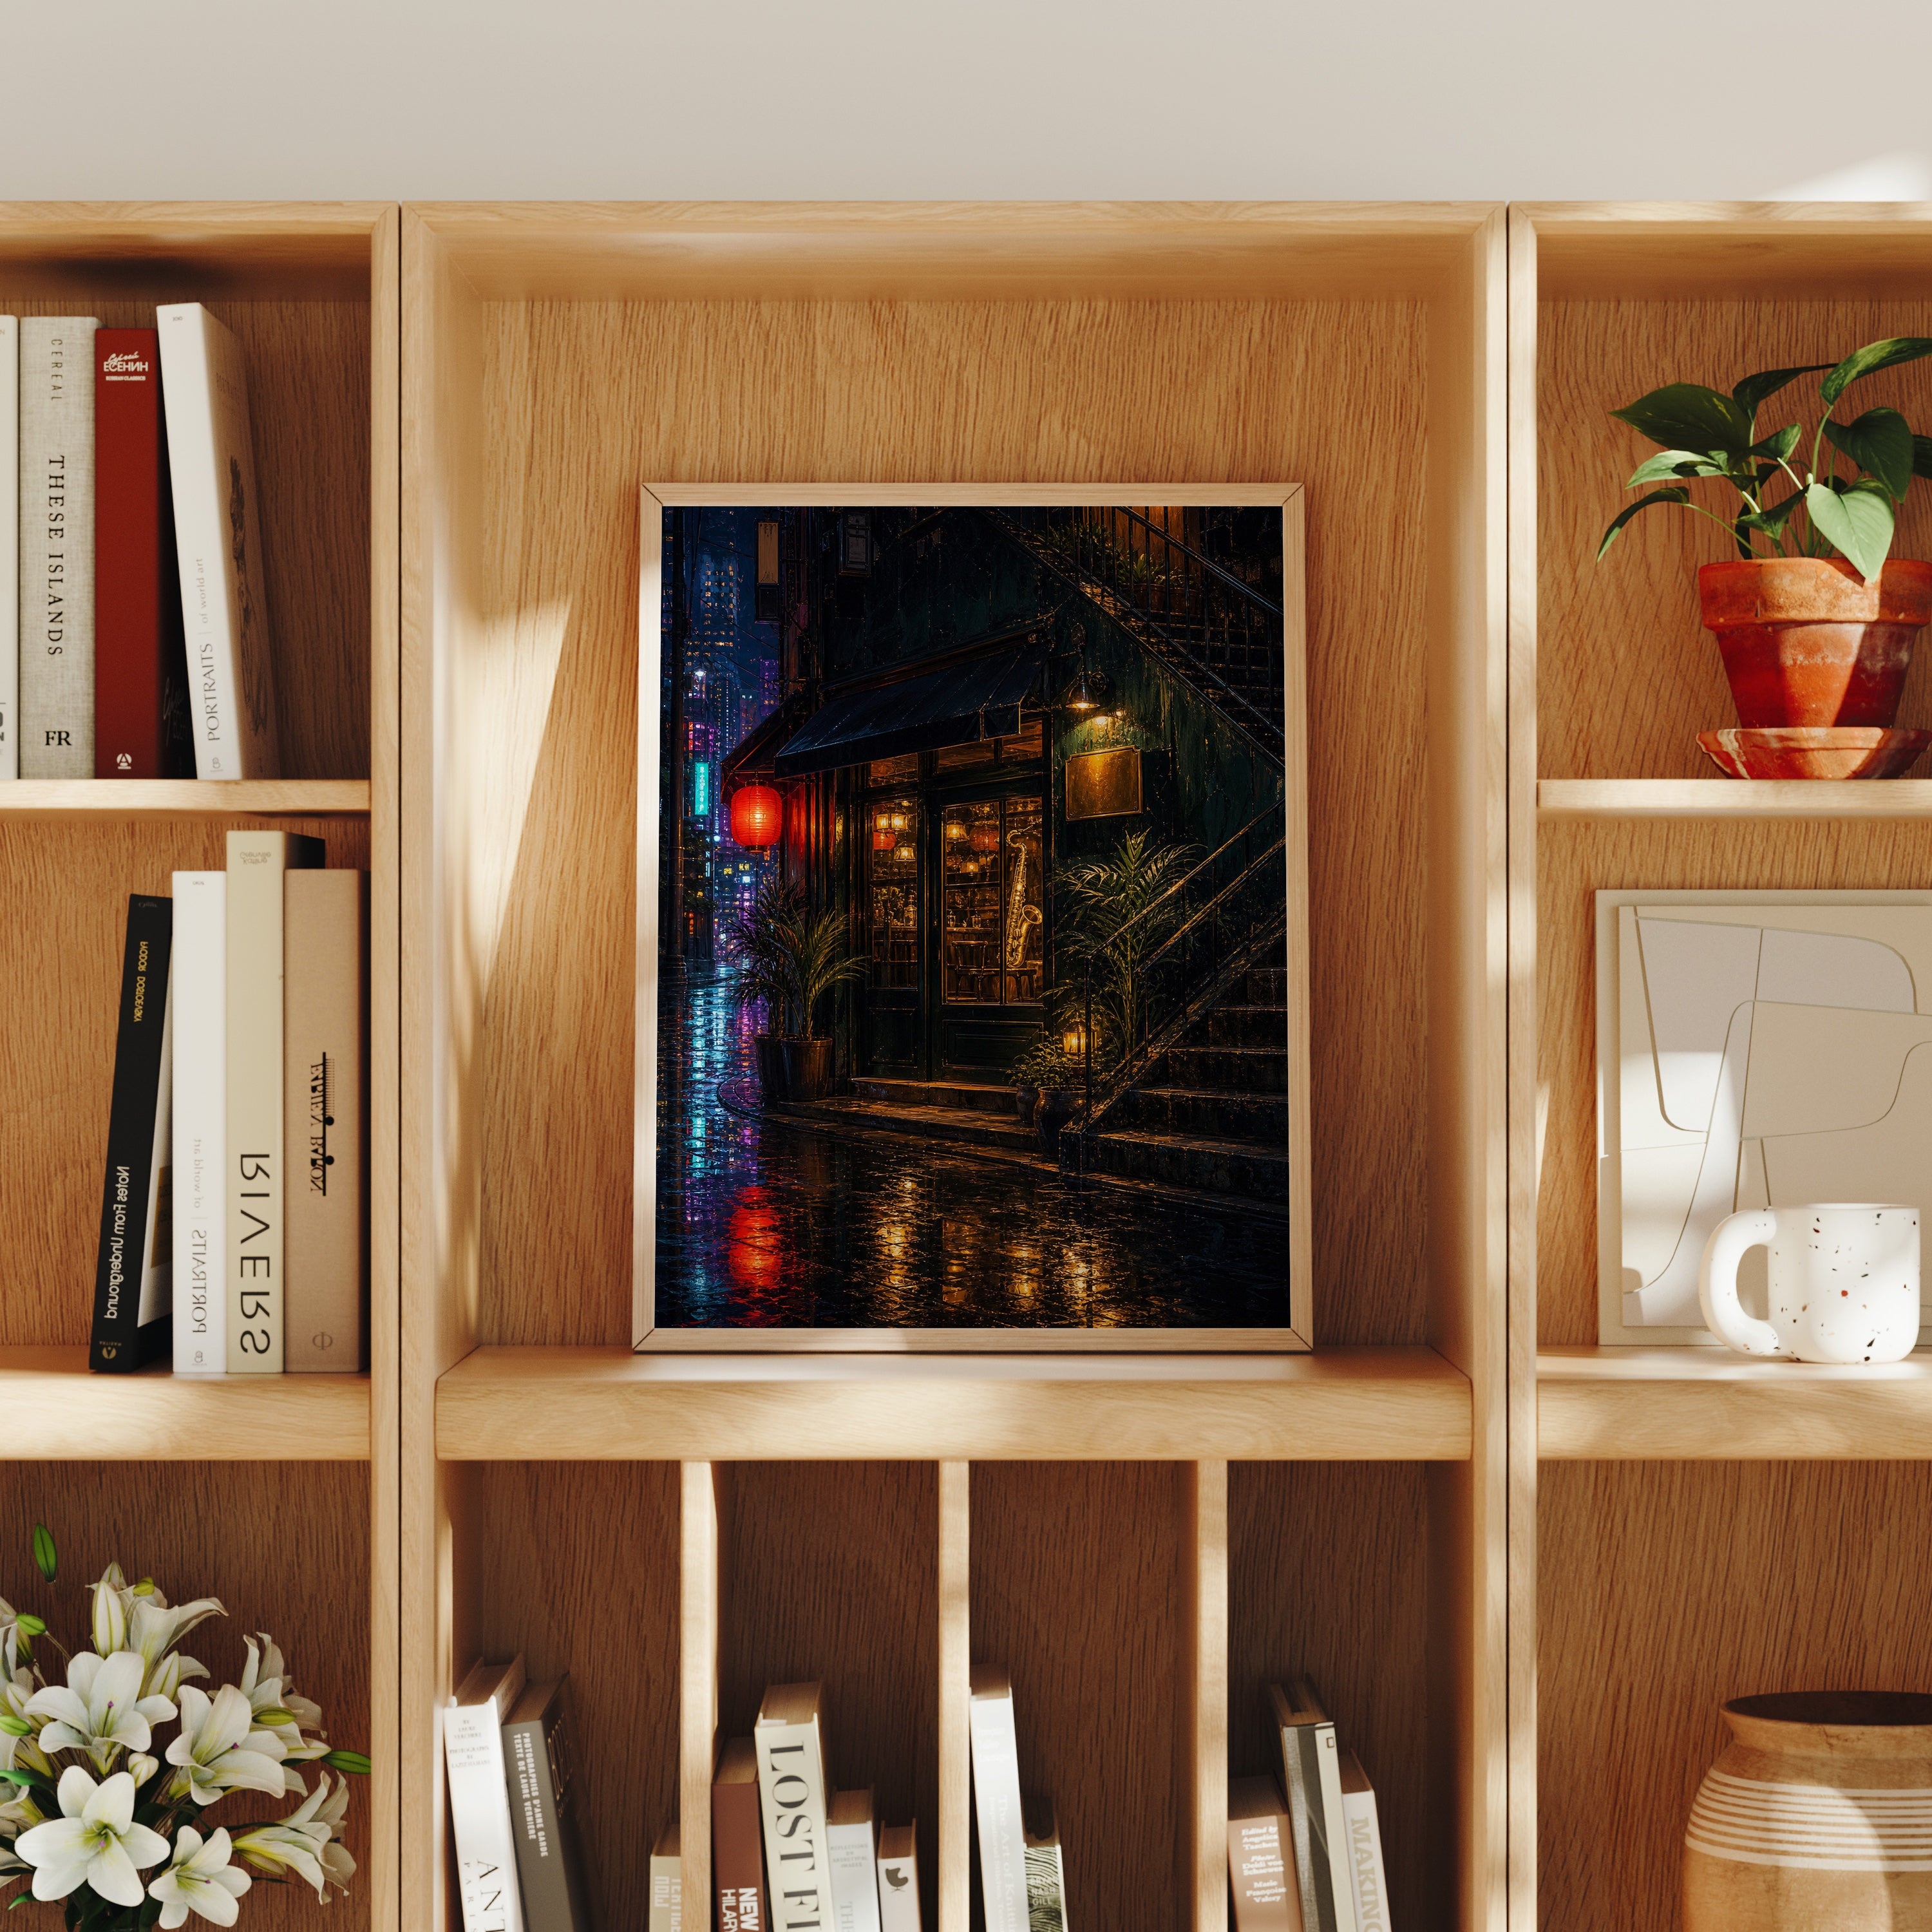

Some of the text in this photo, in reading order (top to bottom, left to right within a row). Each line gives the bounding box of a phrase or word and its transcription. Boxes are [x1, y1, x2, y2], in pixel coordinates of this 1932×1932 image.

[52, 339, 62, 401] CEREAL
[104, 361, 148, 372] ЕСЕНИН
[48, 455, 65, 656] THESE ISLANDS
[196, 558, 220, 741] PORTRAITS of world art
[45, 730, 72, 746] FR
[513, 1734, 524, 1759] TEXTE
[517, 1760, 526, 1772] DE
[519, 1774, 530, 1799] LAURE
[523, 1732, 539, 1797] PHOTOGRAPHIES
[537, 1830, 548, 1857] GARDE
[769, 1741, 816, 1871] LOST
[999, 1794, 1009, 1826] The
[1001, 1830, 1010, 1857] Art
[1242, 1842, 1278, 1850] Taschen
[1003, 1862, 1014, 1879] of
[739, 1887, 759, 1931] NEW
[1032, 1897, 1052, 1906] GILL
